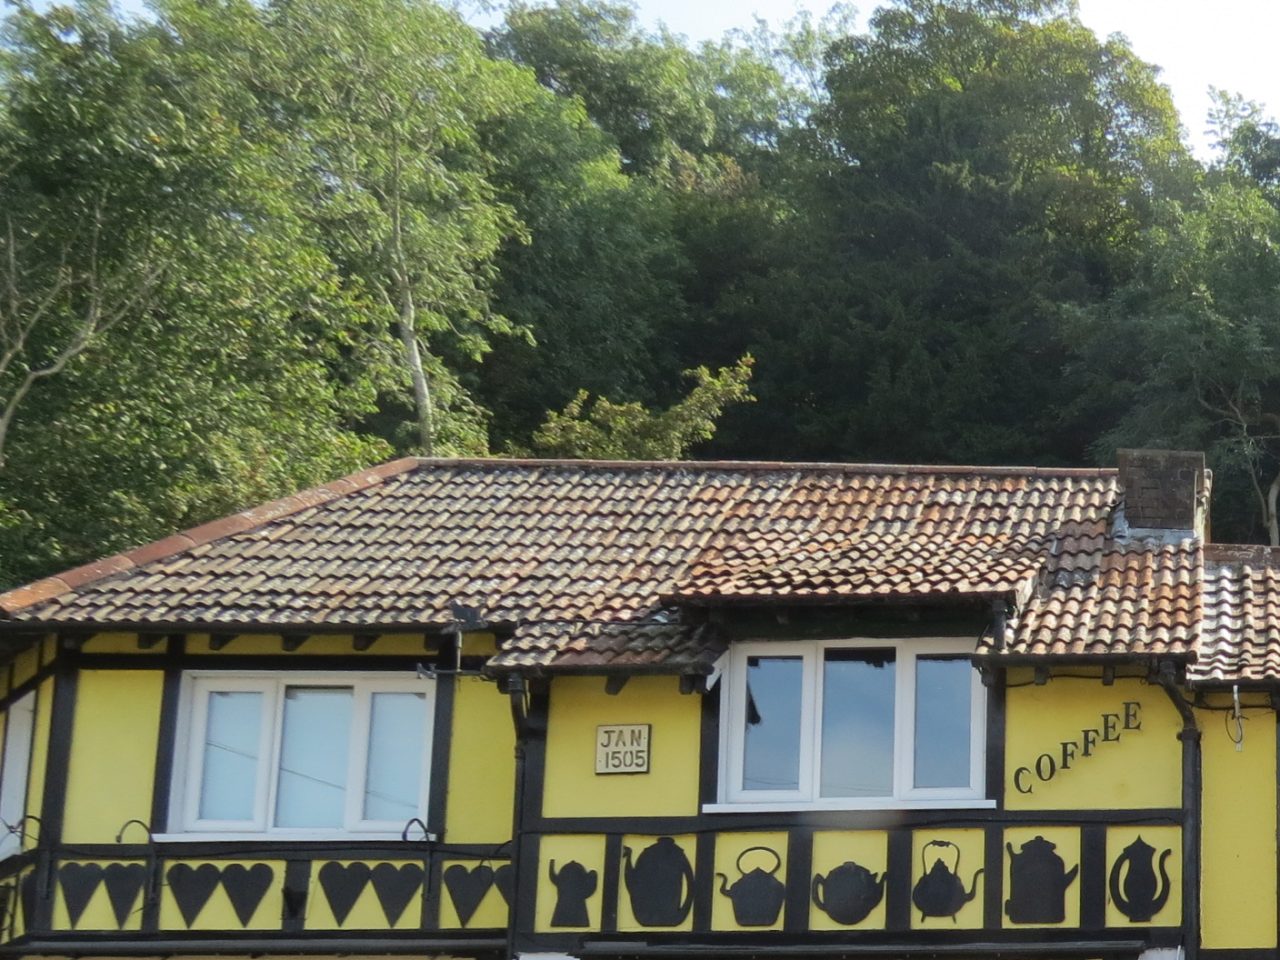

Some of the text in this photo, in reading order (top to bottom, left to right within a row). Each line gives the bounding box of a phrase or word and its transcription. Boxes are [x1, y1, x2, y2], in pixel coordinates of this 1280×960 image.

[600, 729, 642, 747] JAN
[1013, 700, 1142, 794] COFFEE
[605, 749, 646, 768] 1505
